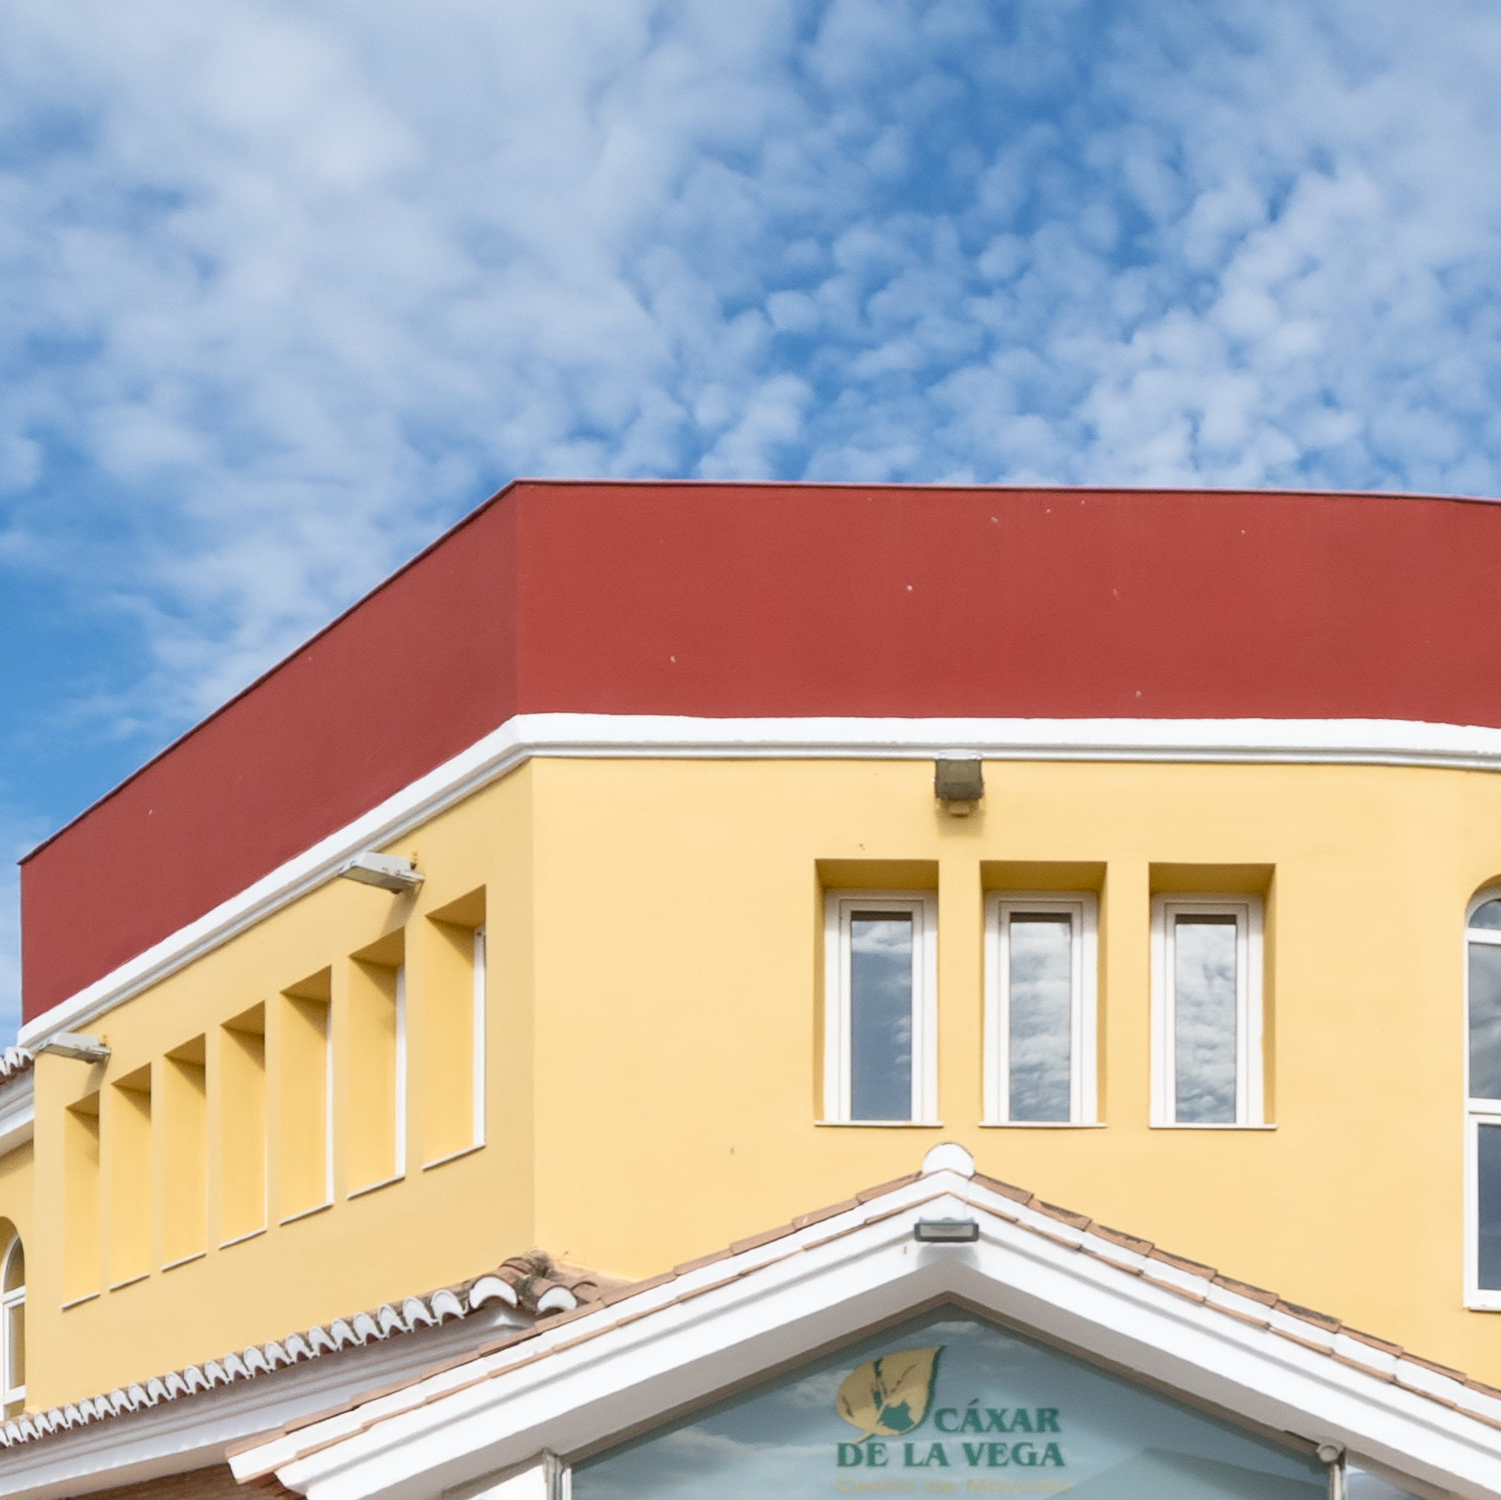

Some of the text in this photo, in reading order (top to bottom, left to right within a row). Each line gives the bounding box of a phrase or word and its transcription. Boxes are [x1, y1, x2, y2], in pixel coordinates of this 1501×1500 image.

[933, 1398, 1062, 1433] CÁXAR
[836, 1442, 1065, 1467] DE LA VEGA
